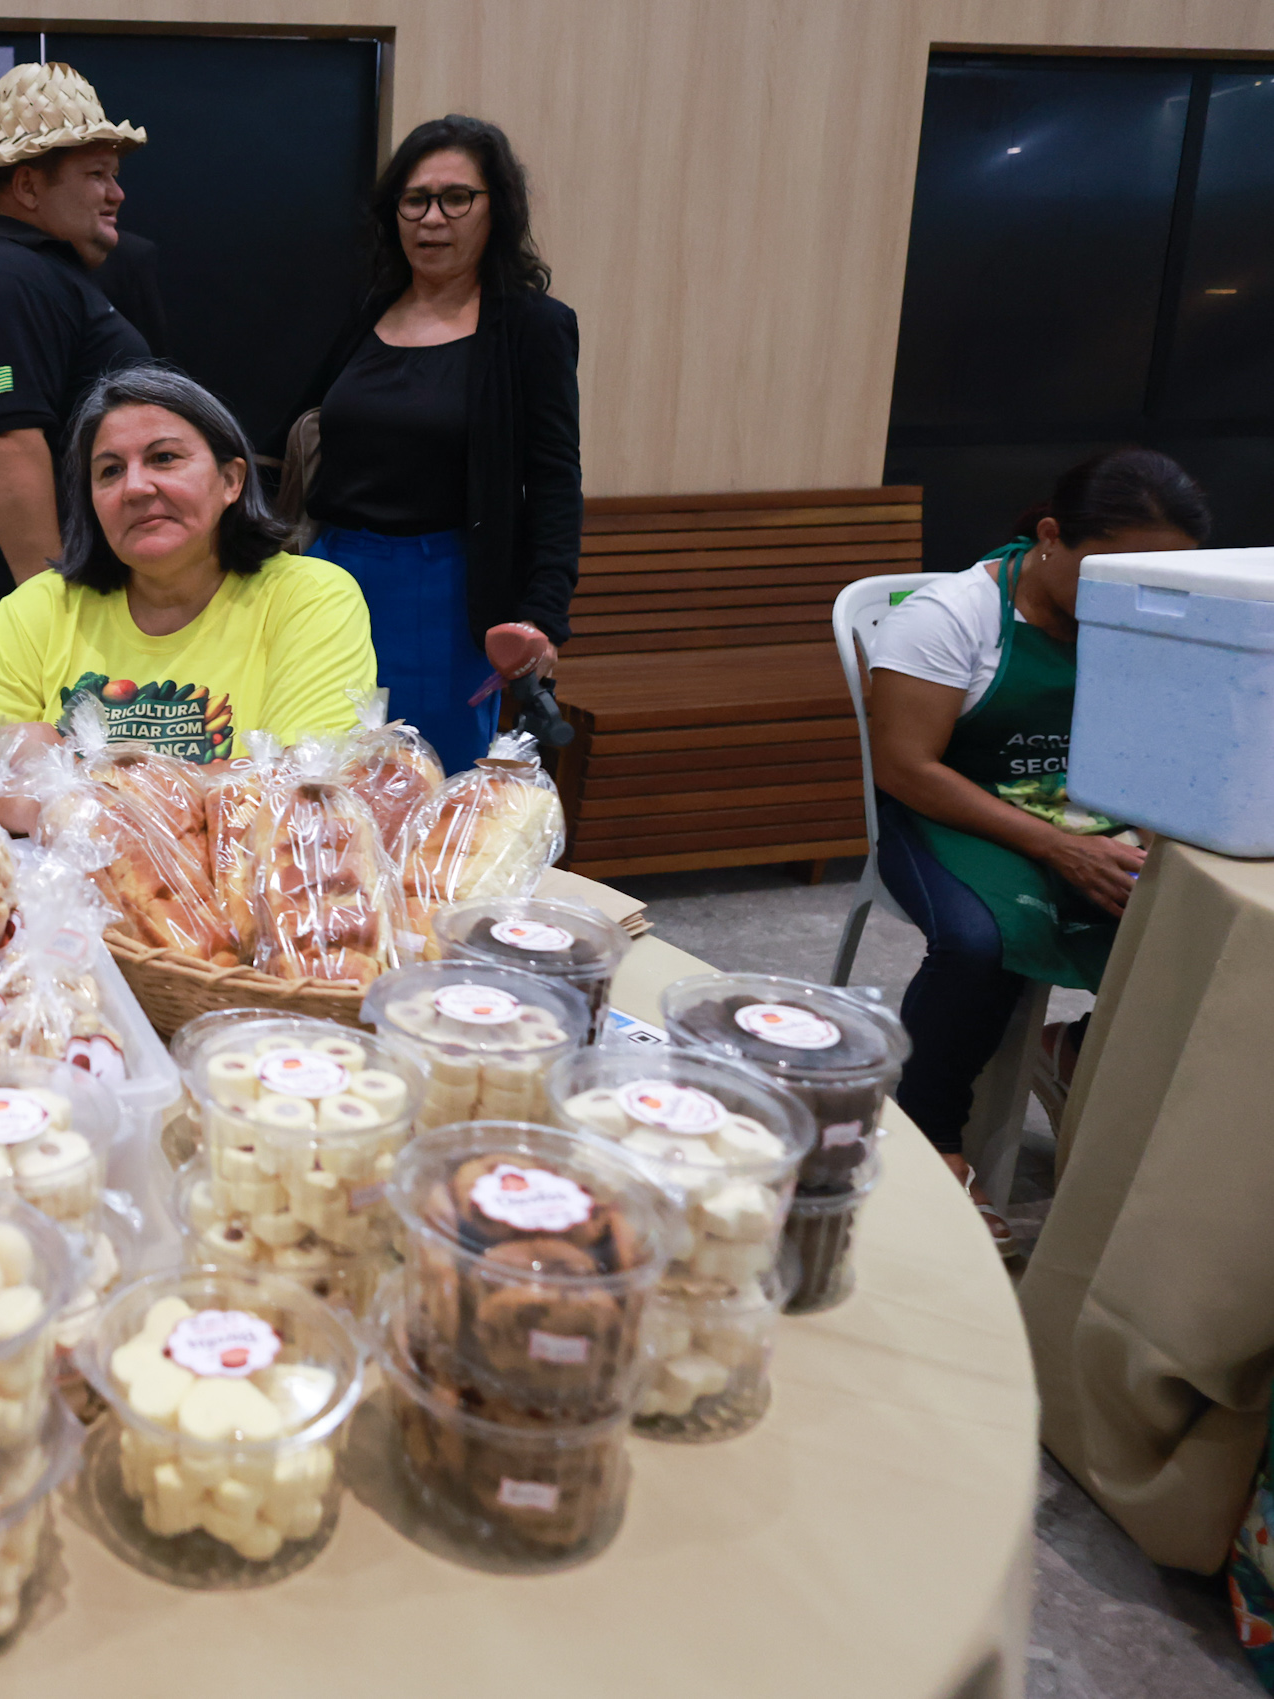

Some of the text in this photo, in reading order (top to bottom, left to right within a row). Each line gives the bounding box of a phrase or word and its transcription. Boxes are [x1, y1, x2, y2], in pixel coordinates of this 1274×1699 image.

[104, 702, 201, 719] GRICULTURA
[108, 722, 203, 737] MILIAR COM
